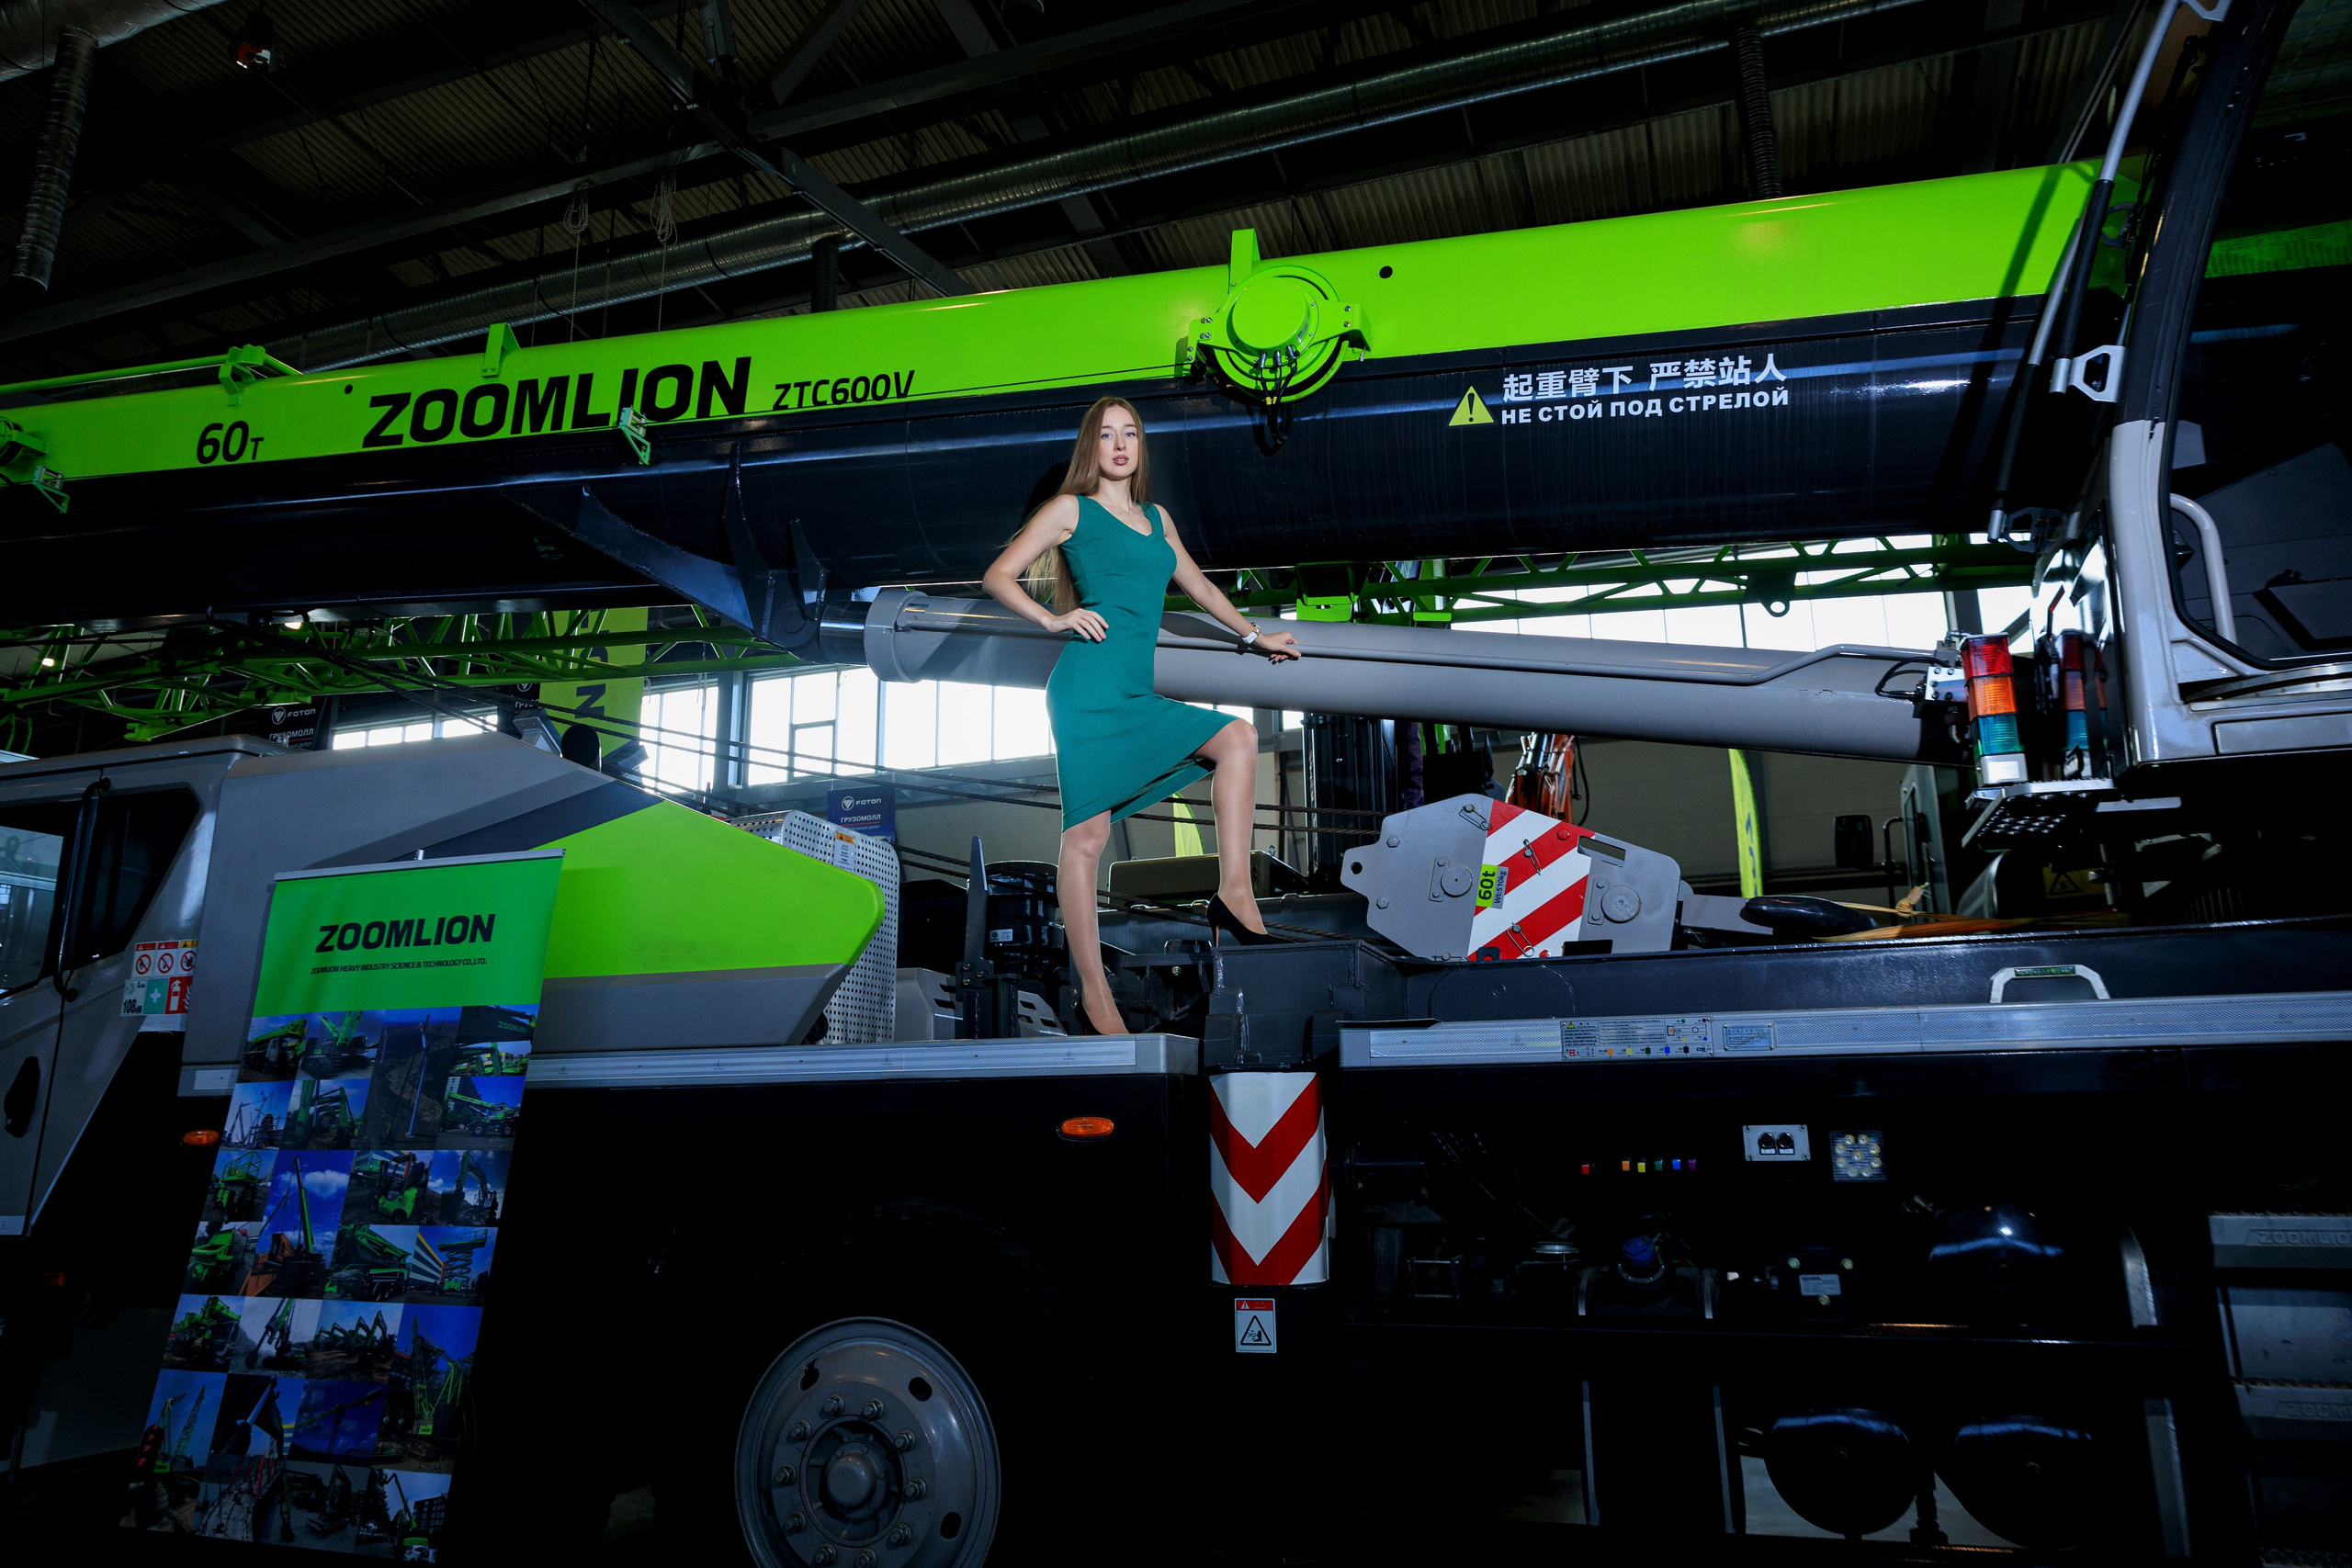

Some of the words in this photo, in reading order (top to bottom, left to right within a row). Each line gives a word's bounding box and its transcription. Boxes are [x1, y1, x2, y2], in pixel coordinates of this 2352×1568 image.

[773, 370, 915, 411] ZTC600V
[1502, 366, 1634, 402] 起重臂下
[1649, 353, 1788, 391] 严禁站人
[362, 356, 752, 448] ZOOMLION
[1502, 409, 1532, 424] НЕ
[1539, 400, 1602, 422] СТОЙ
[1610, 399, 1663, 418] ПОД
[1669, 387, 1789, 412] СТРЕЛОЙ
[287, 708, 317, 718] FOTON
[840, 814, 881, 823] ГРУЗОМОЛЛ
[1478, 870, 1496, 900] 60t
[315, 913, 496, 953] ZOOMLION
[311, 965, 340, 975] ZOOMLION
[340, 964, 361, 973] HEAVY
[361, 962, 391, 971] INDUSTRY
[390, 961, 417, 970] SCIENCE
[423, 959, 462, 968] TECHNOLOGY
